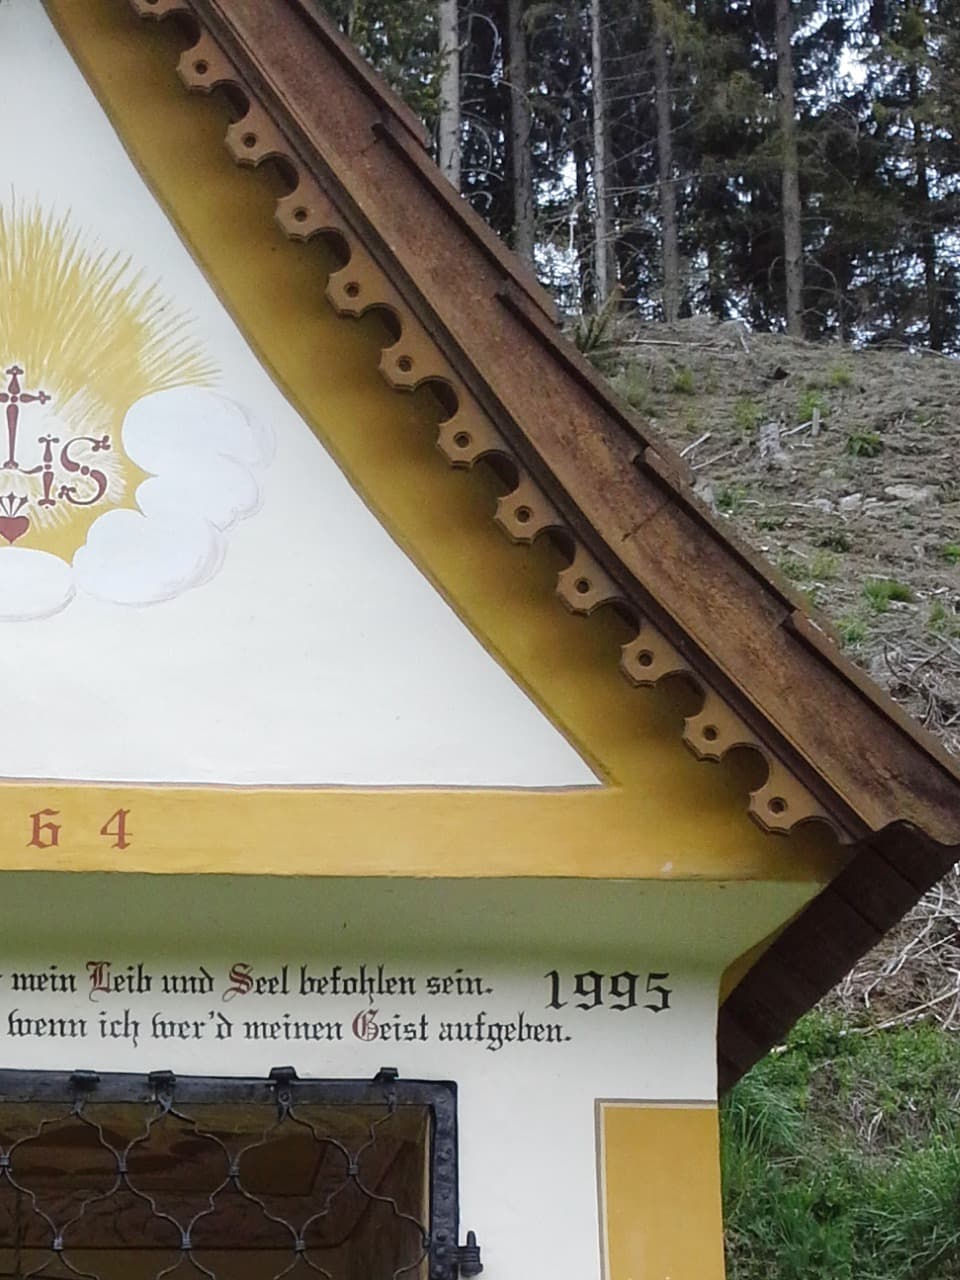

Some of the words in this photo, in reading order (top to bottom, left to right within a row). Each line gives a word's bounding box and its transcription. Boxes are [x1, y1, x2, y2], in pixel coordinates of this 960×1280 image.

[11, 963, 77, 993] mein
[86, 961, 152, 1002] Leib
[161, 966, 214, 994] und
[222, 963, 289, 1002] Seel
[299, 964, 416, 1004] befohlen
[426, 969, 493, 996] sein.
[544, 970, 672, 1013] 1995
[7, 1008, 87, 1038] wenn
[99, 1009, 139, 1048] ich
[243, 1013, 343, 1041] meinen
[352, 1008, 429, 1042] Geist
[438, 1011, 572, 1051] aufgeben.
